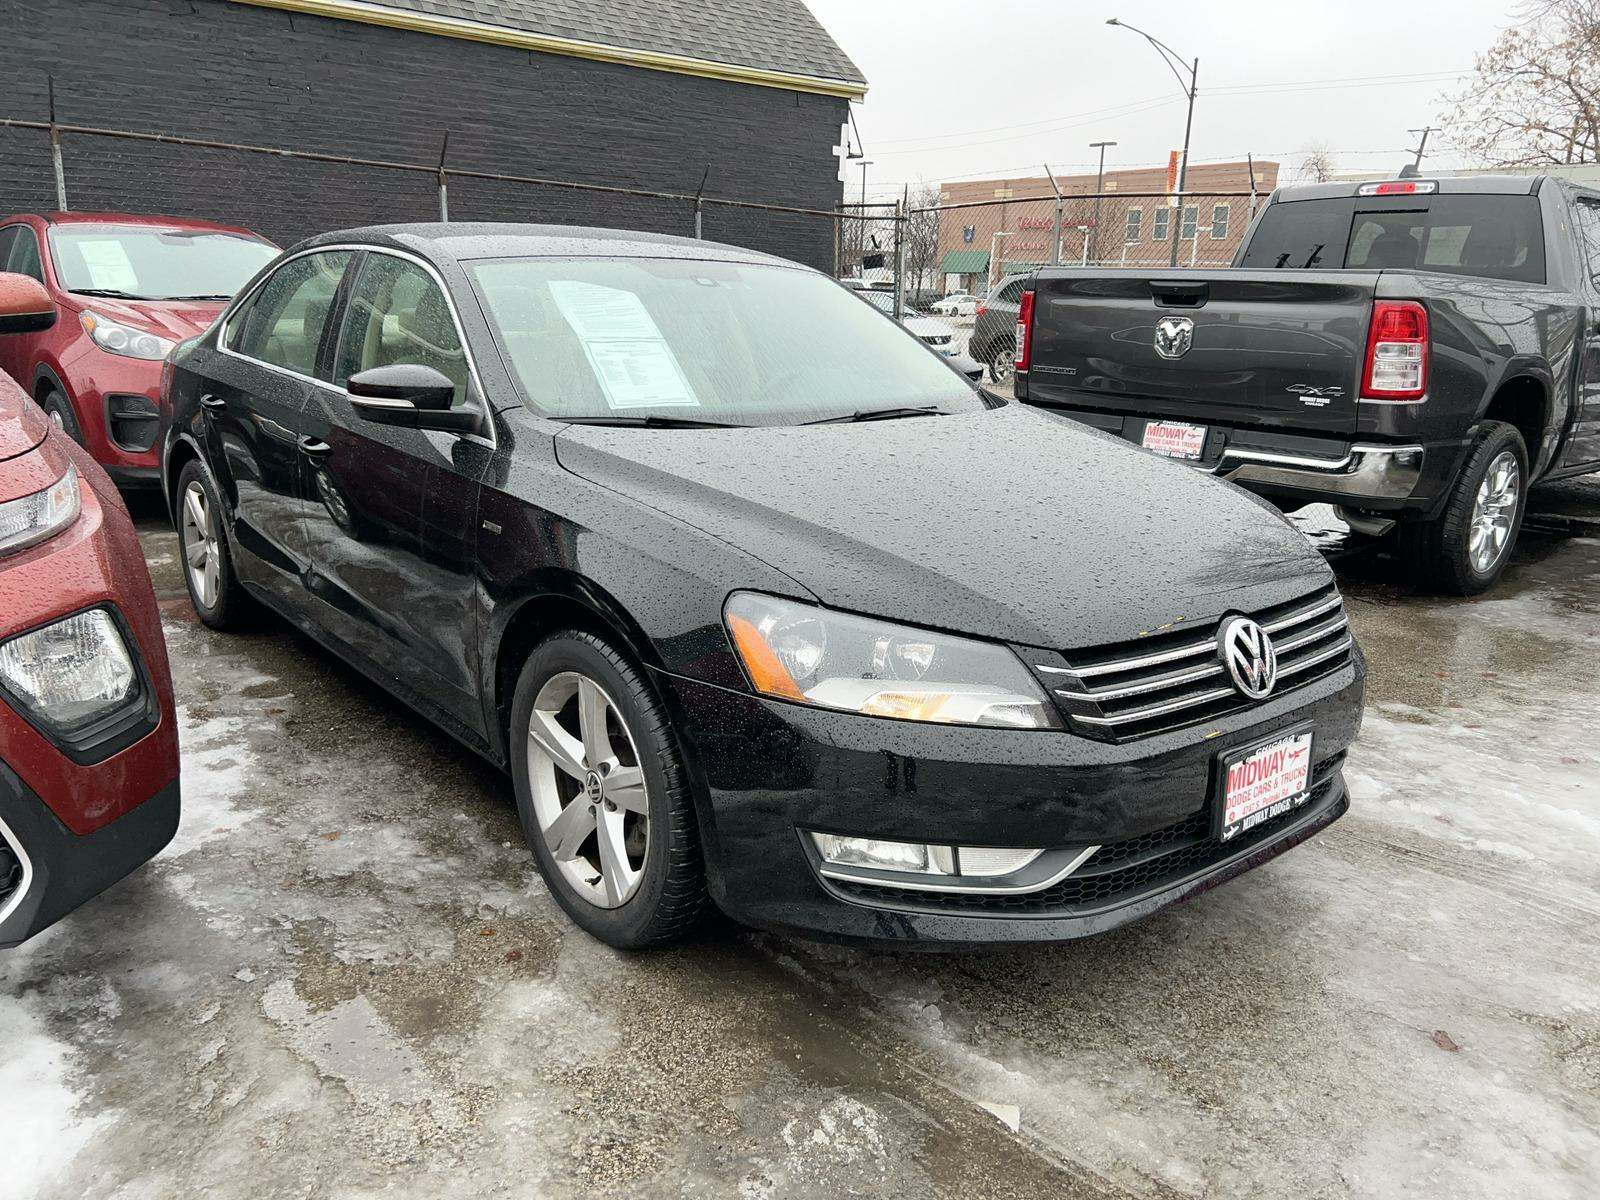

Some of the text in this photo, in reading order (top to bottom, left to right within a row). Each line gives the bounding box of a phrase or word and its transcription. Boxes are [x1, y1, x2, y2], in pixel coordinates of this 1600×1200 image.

[1147, 426, 1187, 440] MIDWAY
[1226, 788, 1252, 809] DODGE
[1253, 780, 1272, 798] CARS
[1280, 765, 1307, 786] TRUCKS
[1227, 748, 1288, 793] MIDWAY
[1243, 799, 1291, 831] MIDWAY DODGE
